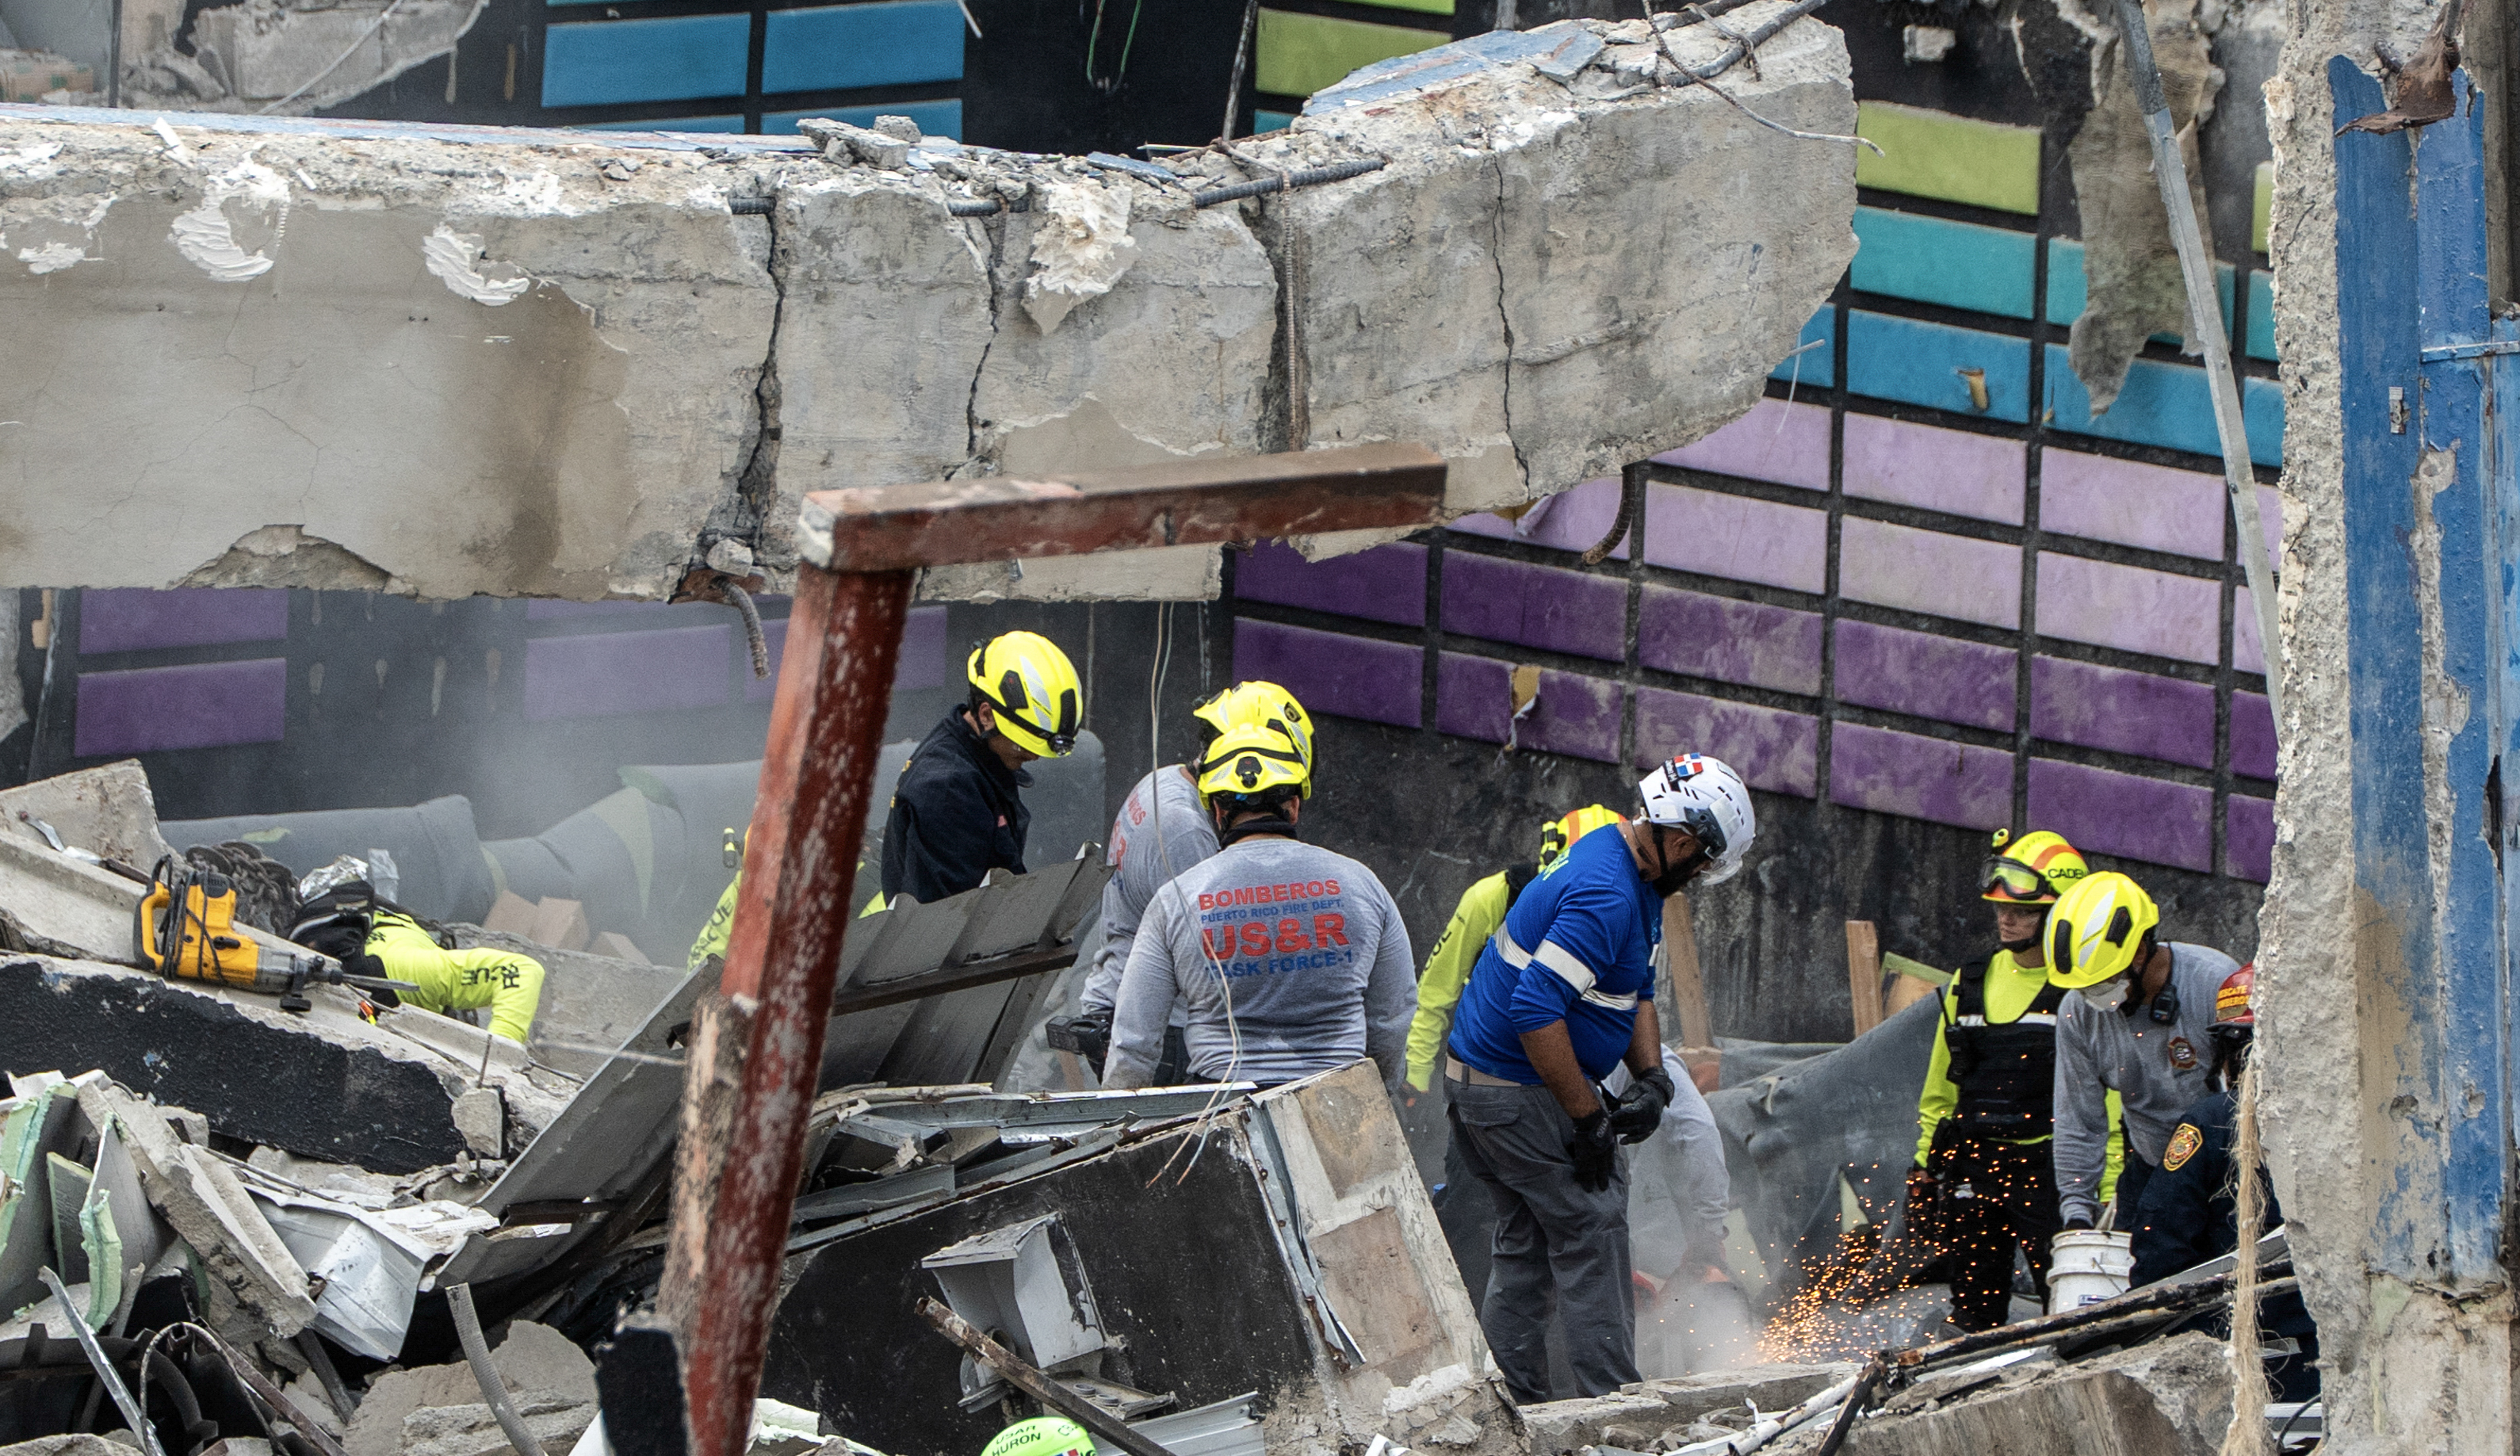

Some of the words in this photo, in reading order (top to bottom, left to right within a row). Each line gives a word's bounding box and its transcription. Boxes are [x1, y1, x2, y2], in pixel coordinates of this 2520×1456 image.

[1199, 879, 1341, 911] BOMBEROS
[1201, 909, 1247, 924] PUERTO
[1251, 906, 1279, 918] RICO
[1283, 903, 1308, 915] FIRE
[1312, 899, 1345, 911] DEPT.
[1202, 912, 1351, 961] US&R
[1268, 950, 1353, 975] FORCE-1
[992, 1432, 1042, 1456] HURON
